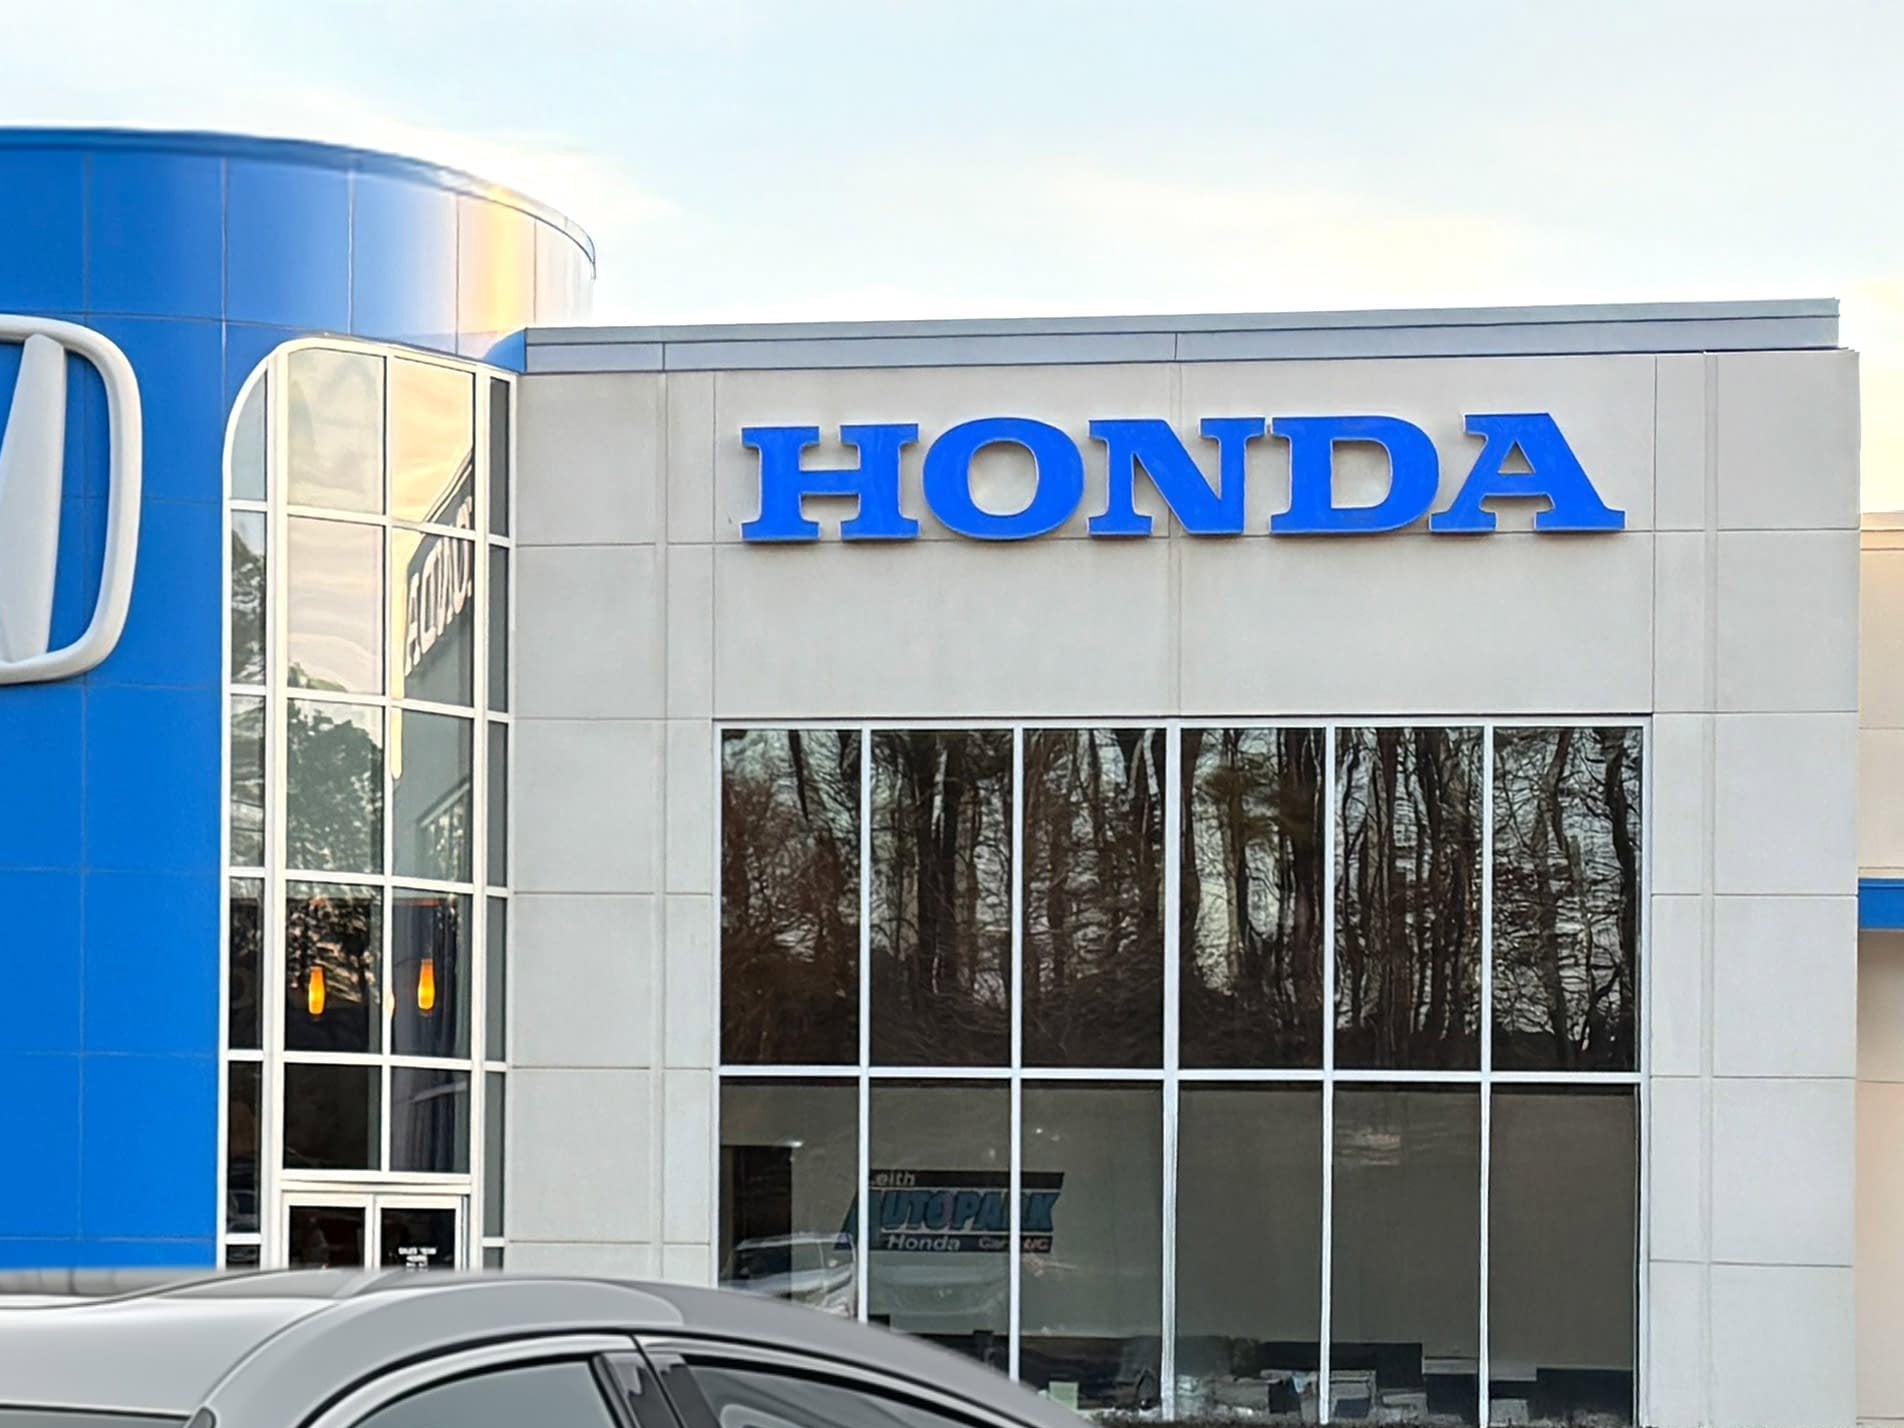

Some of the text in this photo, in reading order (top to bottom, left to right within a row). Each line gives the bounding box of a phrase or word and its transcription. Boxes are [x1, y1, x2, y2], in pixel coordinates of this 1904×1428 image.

[741, 411, 1626, 543] HONDA
[871, 1172, 915, 1187] eith
[887, 1234, 961, 1251] Honda
